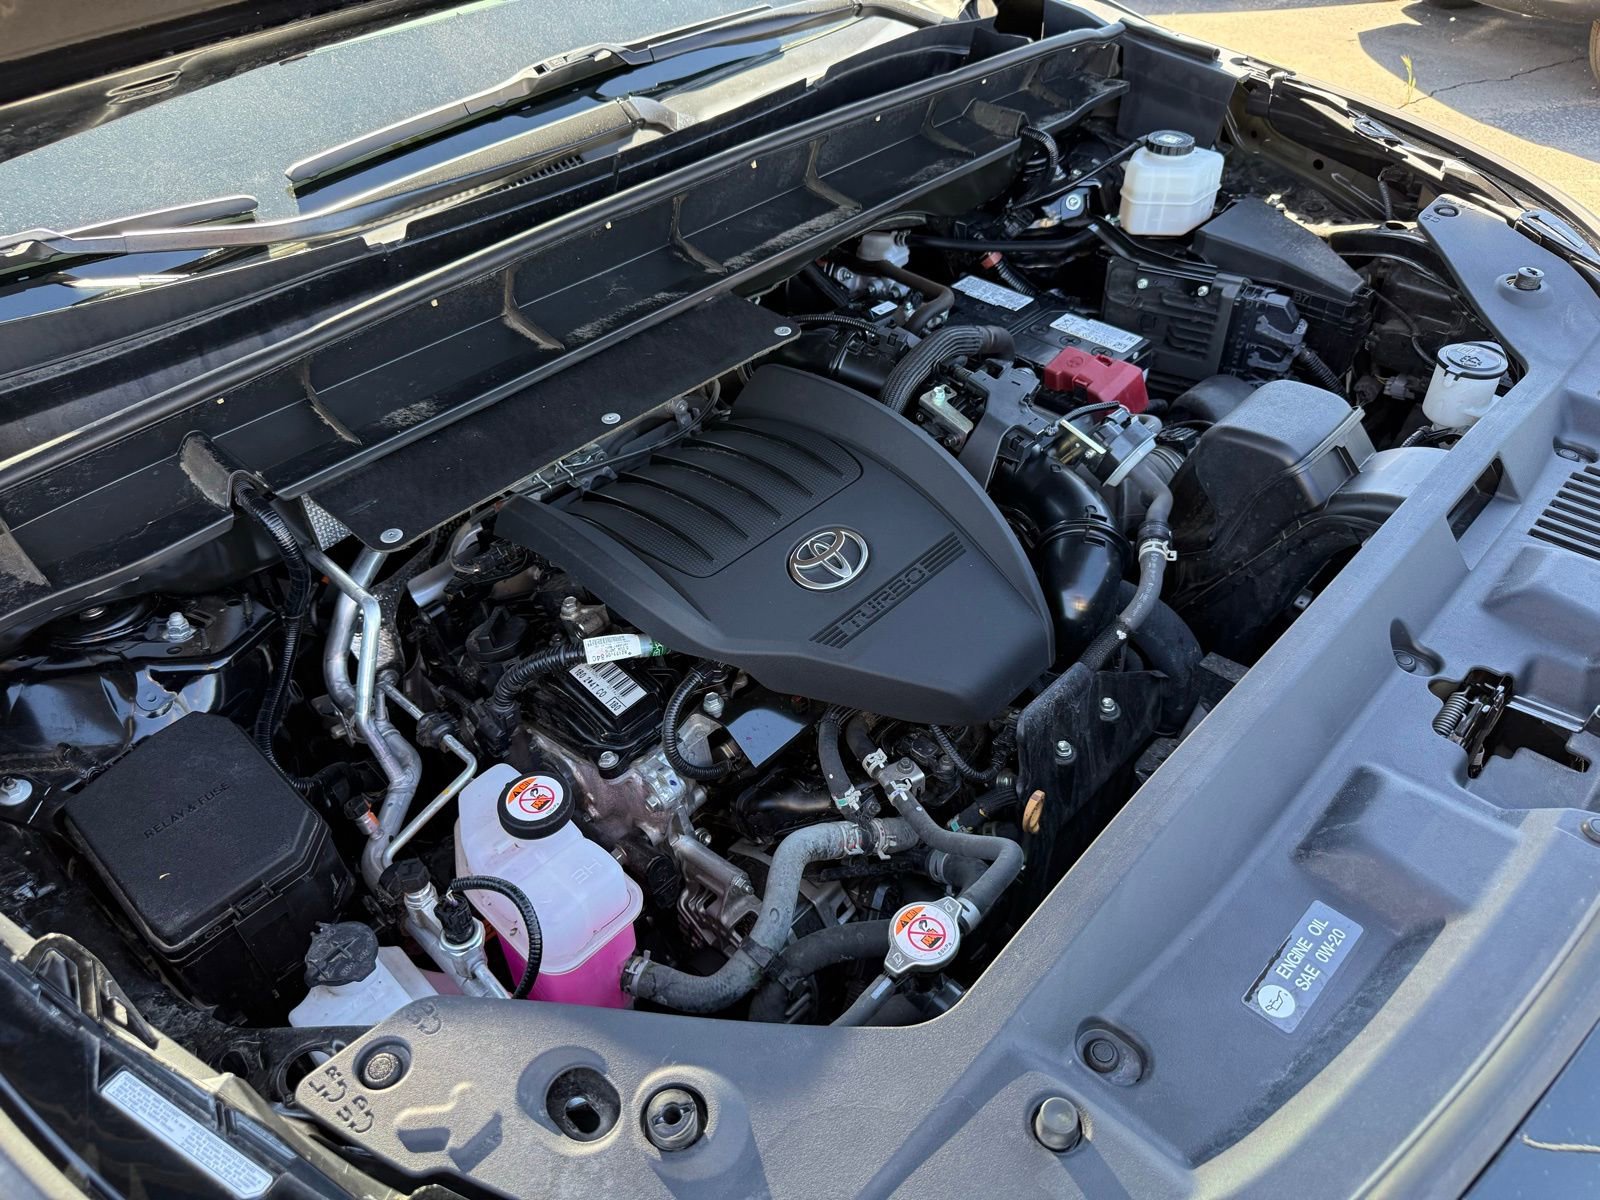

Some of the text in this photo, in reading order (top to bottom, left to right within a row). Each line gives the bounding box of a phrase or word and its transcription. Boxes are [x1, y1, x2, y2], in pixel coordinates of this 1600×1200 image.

[841, 567, 926, 628] TURBO
[143, 781, 231, 839] RELAY & FUSE
[1275, 919, 1329, 980] ENGINE OIL
[1295, 928, 1346, 991] SAE 0W-20
